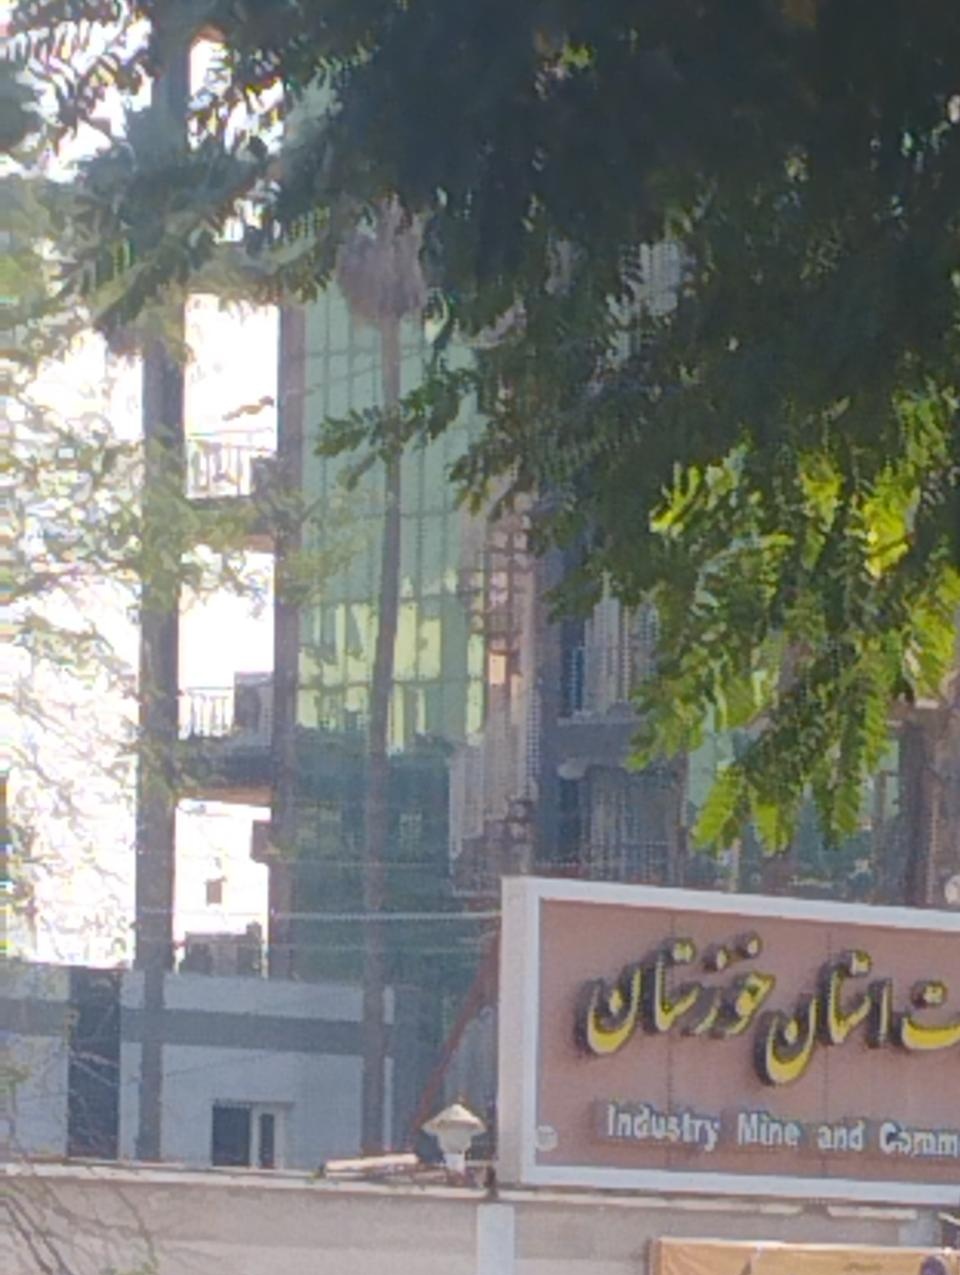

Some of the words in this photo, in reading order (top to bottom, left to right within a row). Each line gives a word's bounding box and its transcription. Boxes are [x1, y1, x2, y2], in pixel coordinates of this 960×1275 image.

[584, 936, 777, 1056] خوزستان
[762, 950, 894, 1085] استان
[607, 1103, 721, 1152] Industry
[737, 1111, 801, 1147] Mine
[817, 1120, 865, 1152] and
